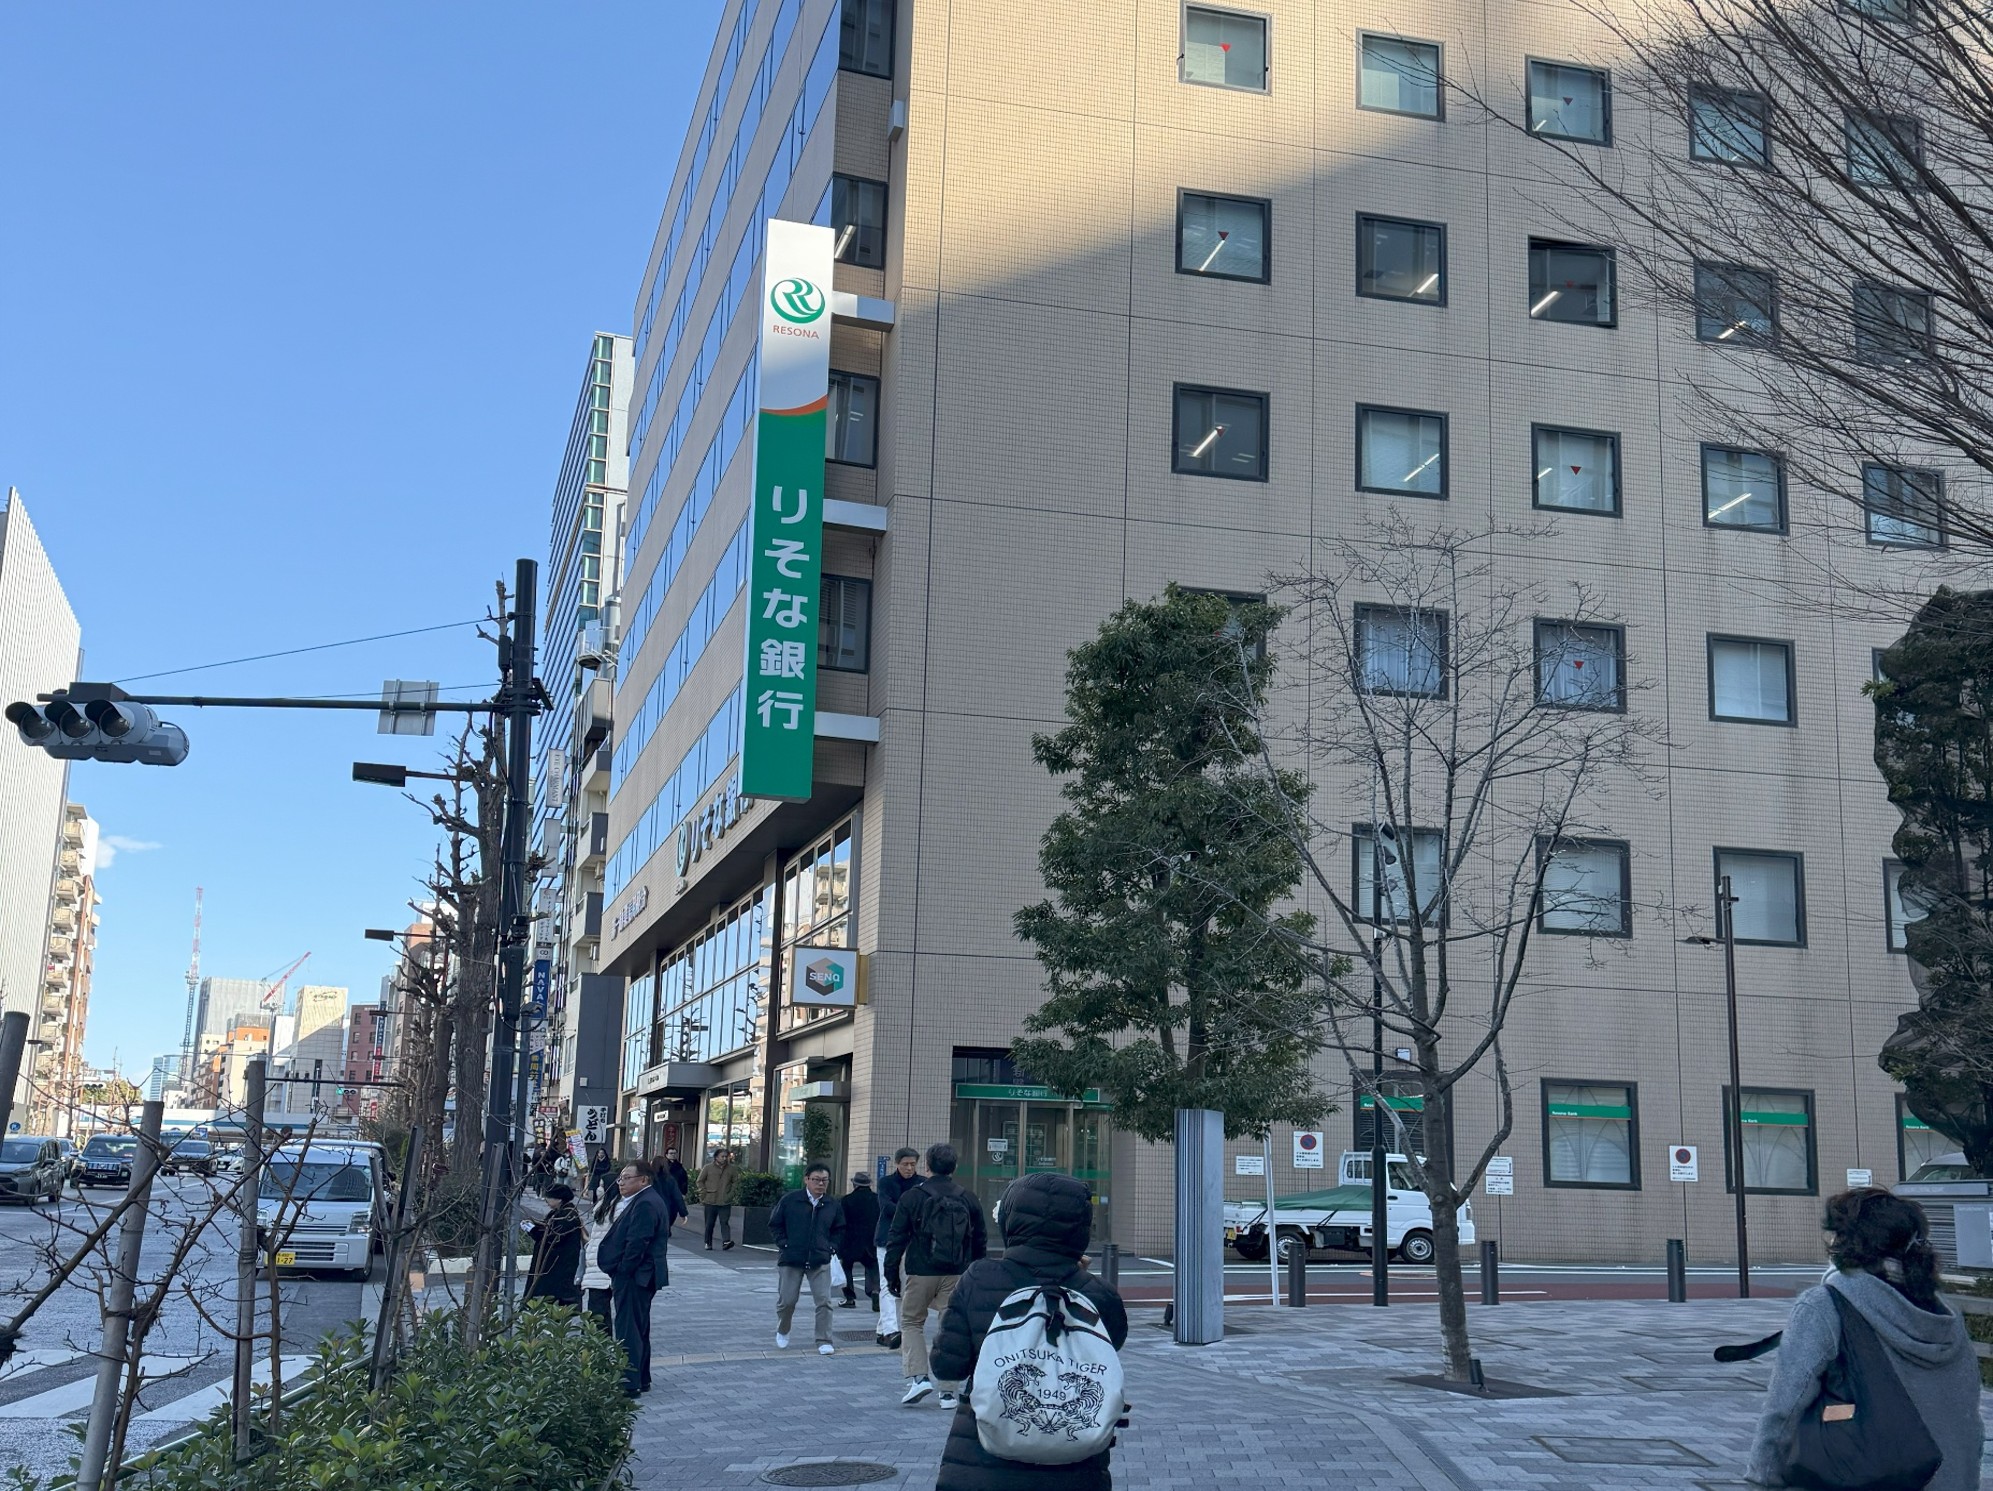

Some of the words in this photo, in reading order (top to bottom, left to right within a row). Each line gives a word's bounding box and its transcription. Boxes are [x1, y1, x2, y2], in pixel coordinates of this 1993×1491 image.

[772, 325, 820, 340] RESONA
[757, 485, 810, 730] りそな銀行
[809, 972, 840, 982] SENQ
[993, 1348, 1064, 1369] ONITSUKA
[1068, 1357, 1108, 1376] TIGER
[1037, 1388, 1067, 1401] 1949
